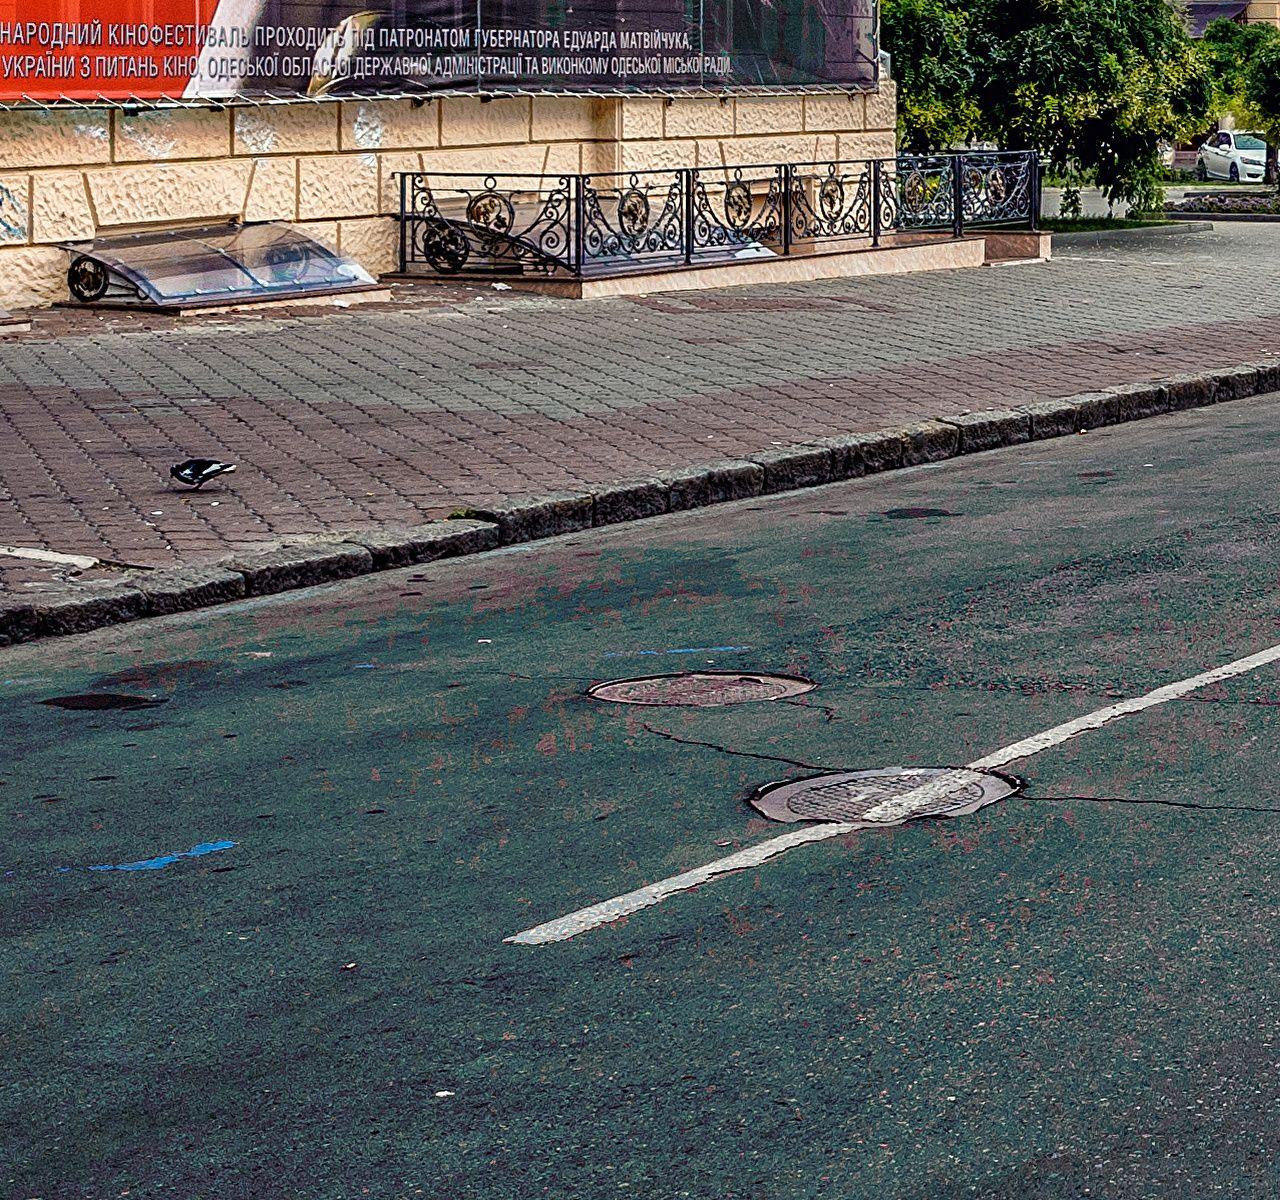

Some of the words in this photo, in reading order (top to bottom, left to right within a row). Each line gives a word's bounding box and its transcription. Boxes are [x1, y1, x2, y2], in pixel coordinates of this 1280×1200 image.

[0, 19, 102, 49] НАРОДНИЙ
[108, 23, 249, 48] КІНОФЕСТИВАЛЬ
[255, 26, 346, 50] ПРОХОДИТЬ
[351, 28, 375, 50] ПІД
[379, 28, 470, 48] ПАТРОНАТОМ
[474, 29, 560, 48] ГУБЕРНАТОРА
[564, 30, 617, 52] ЕДУАРДА
[620, 29, 693, 51] МАТВІЙЧУКА,
[2, 50, 76, 79] УКРАЇНИ
[80, 56, 91, 79] З
[95, 55, 158, 78] ПИТАНЬ
[208, 53, 280, 81] ОДЕСЬКОЇ
[282, 54, 351, 77] ОБЛАСНОЇ
[354, 53, 432, 80] ДЕРЖАВНОЇ
[434, 52, 523, 78] АДМІНІСТРАЦІЇ
[525, 56, 540, 75] ТА
[542, 56, 609, 75] ВИКОНКОМУ
[611, 52, 662, 77] ОДЕСЬКОЇ
